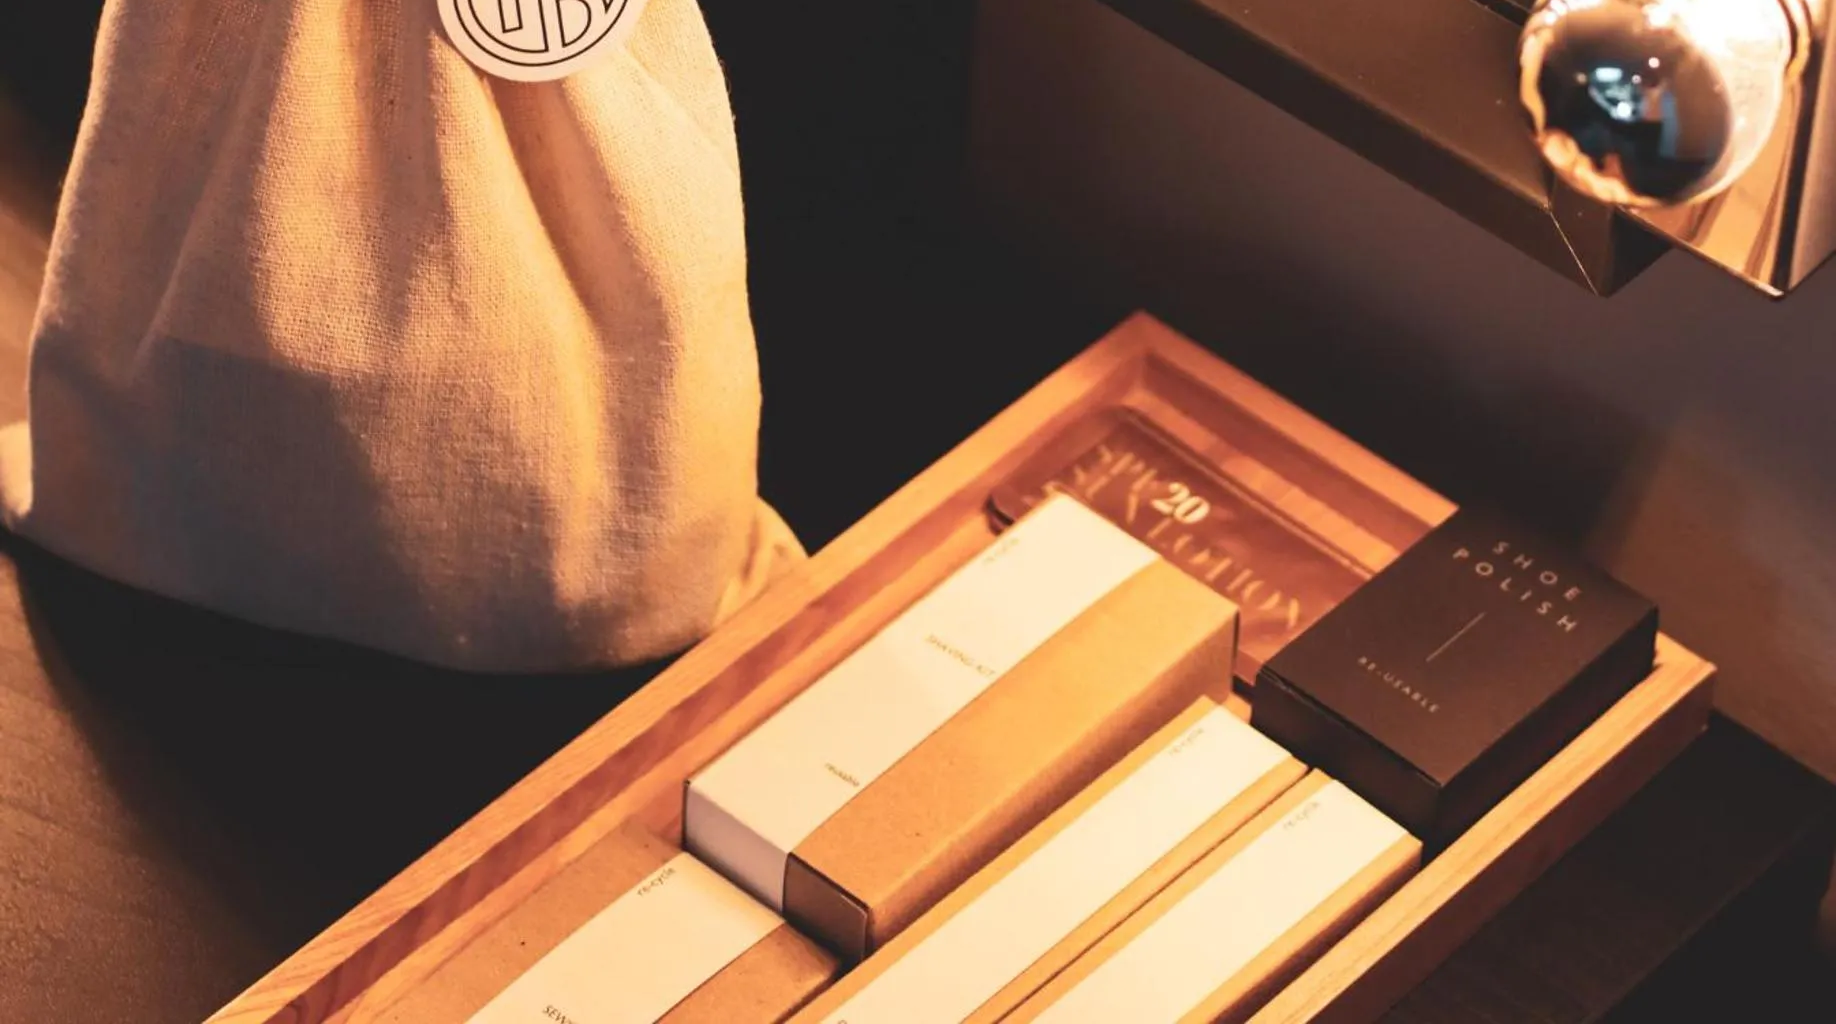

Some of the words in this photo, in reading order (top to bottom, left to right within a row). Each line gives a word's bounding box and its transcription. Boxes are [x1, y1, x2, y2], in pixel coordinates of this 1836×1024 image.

[1151, 481, 1211, 525] 20
[1452, 547, 1578, 633] POLISH
[1492, 540, 1583, 602] SHOE
[1357, 656, 1440, 714] RE-USABLE
